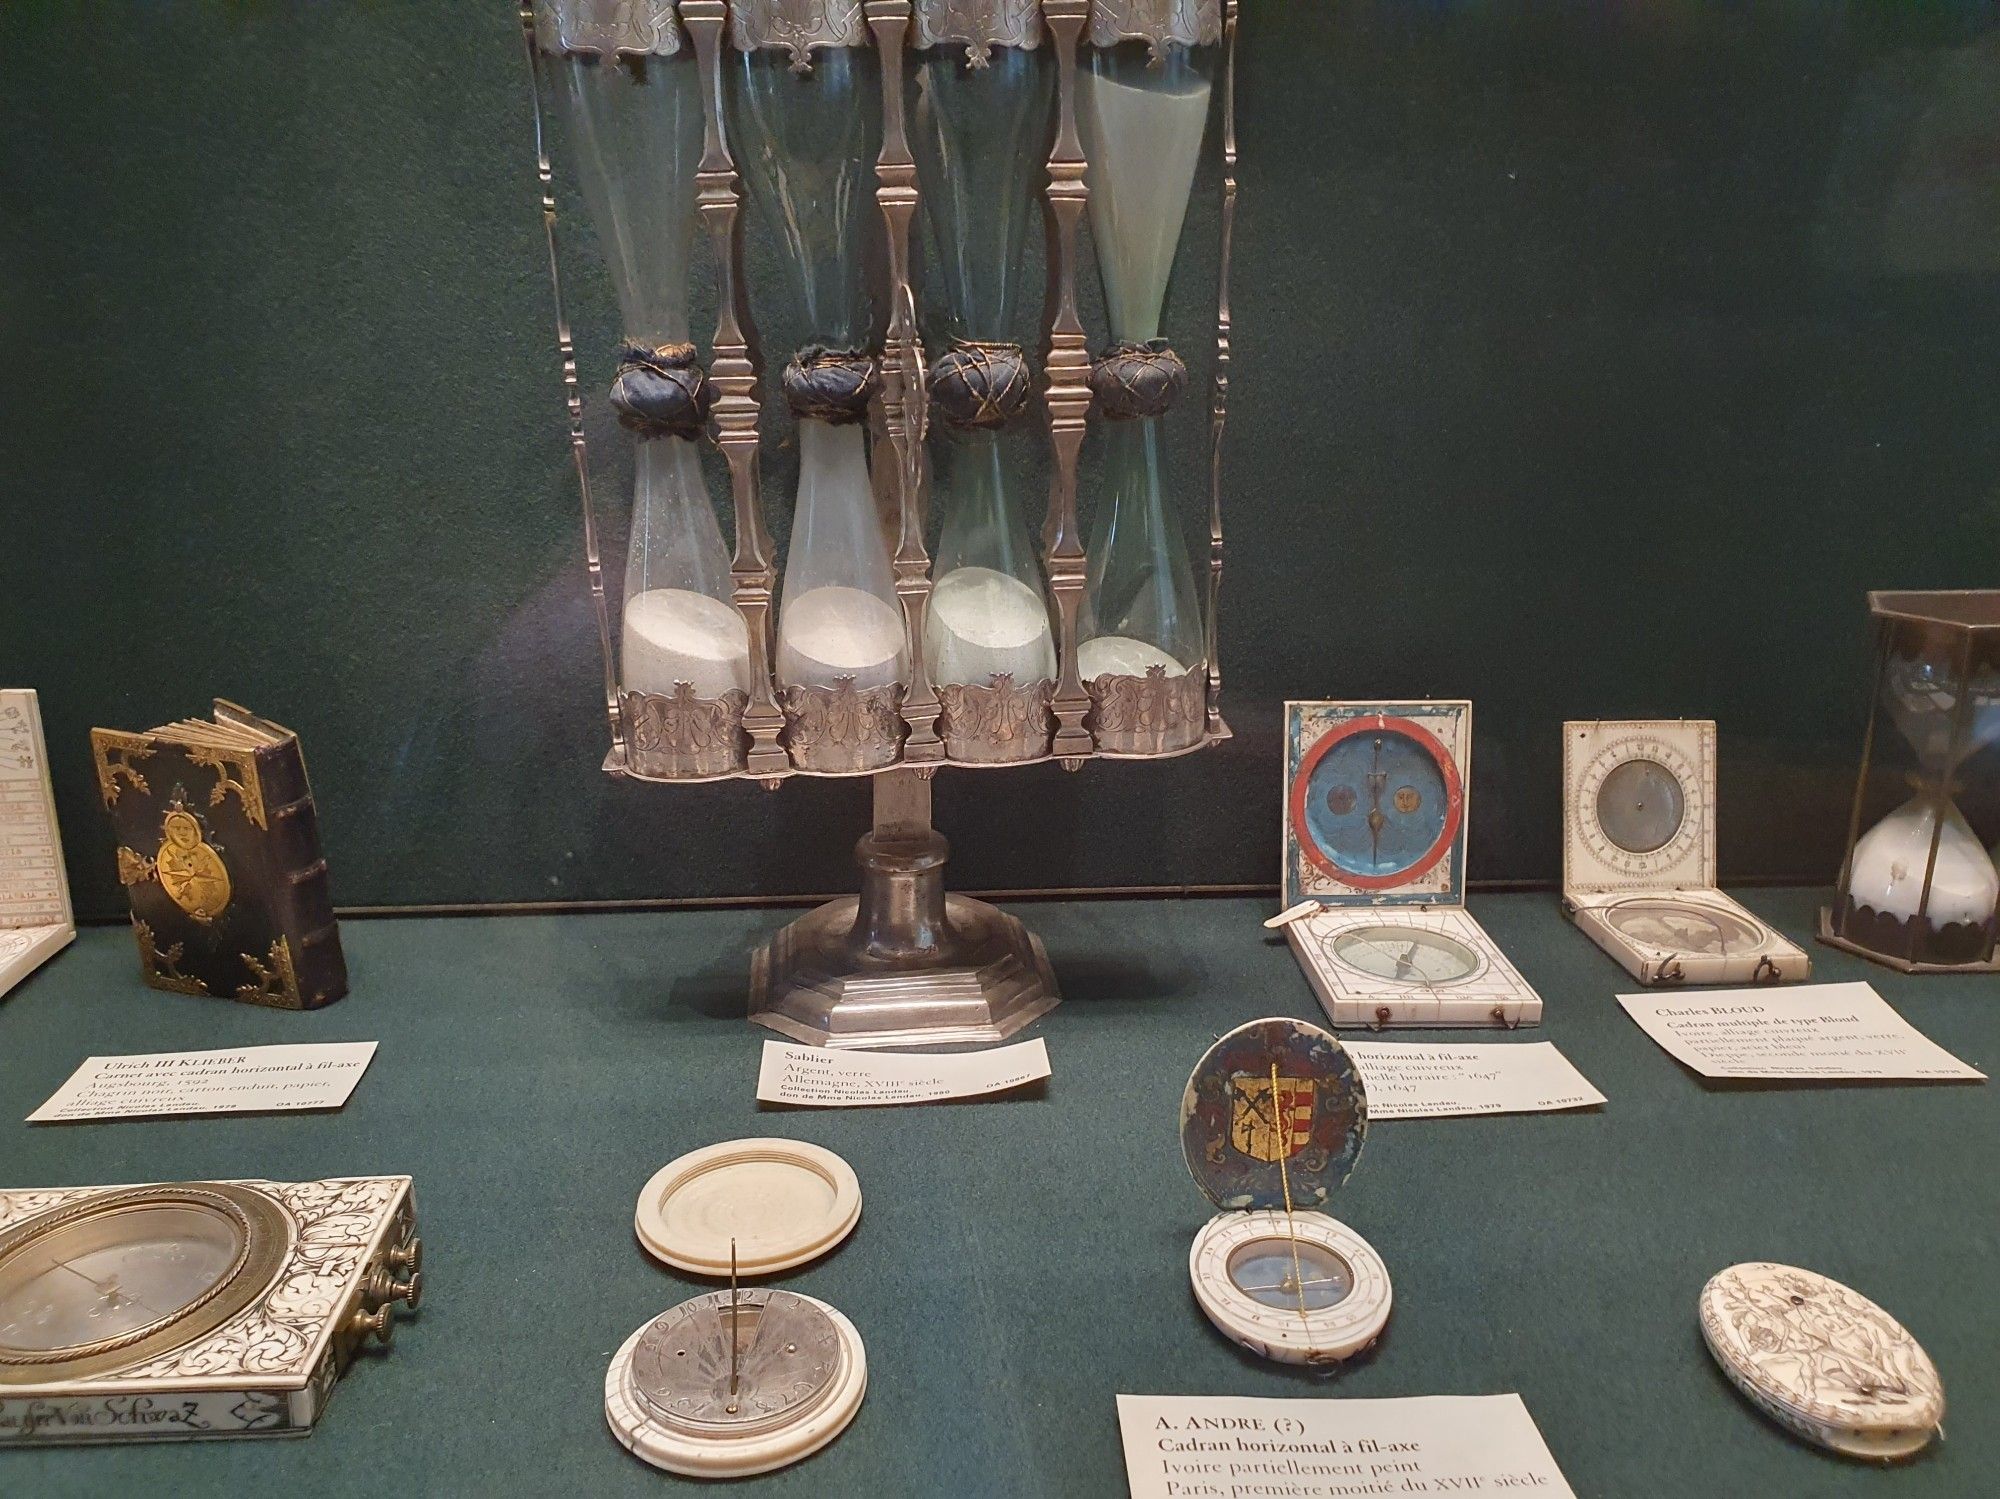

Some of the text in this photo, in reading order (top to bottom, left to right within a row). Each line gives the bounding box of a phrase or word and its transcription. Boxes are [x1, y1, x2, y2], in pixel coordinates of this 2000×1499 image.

[1655, 1006, 1765, 1017] Charles BLOUD
[1666, 1021, 1715, 1029] Cadran
[1717, 1018, 1770, 1028] multiple
[1790, 1018, 1819, 1026] type
[1819, 1014, 1860, 1023] Bloud
[1721, 1028, 1760, 1037] alliage
[784, 1051, 834, 1064] Sablier
[1357, 1051, 1425, 1061] horizontal
[1429, 1052, 1436, 1061] à
[1438, 1052, 1479, 1061] fil-axe
[104, 1056, 247, 1070] Ulrich III KLIEBER
[1359, 1062, 1463, 1072] alliage cuivreux
[94, 1071, 143, 1080] Carnet
[180, 1068, 227, 1077] cadran
[231, 1062, 304, 1074] horizontal
[305, 1062, 313, 1071] à
[316, 1060, 361, 1070] fil-axe
[784, 1063, 872, 1078] Argent, verre
[1363, 1072, 1397, 1081] helle
[1399, 1072, 1450, 1081] horaire
[782, 1074, 860, 1089] Allemagne,
[909, 1077, 944, 1087] siècle
[986, 1081, 1001, 1089] OA
[1387, 1083, 1417, 1092] 1647
[76, 1089, 137, 1098] Chagrin
[178, 1085, 225, 1093] carton
[779, 1091, 799, 1099] don
[780, 1084, 831, 1095] Collection
[66, 1099, 117, 1107] alliage
[1155, 1415, 1305, 1436] A. ANDRE (?)
[1157, 1436, 1422, 1454] Cadran horizontal à fil-axe
[1162, 1458, 1422, 1478] Ivoire partiellement peint
[1166, 1480, 1225, 1497] Paris,
[1231, 1480, 1322, 1499] première
[1329, 1479, 1393, 1496] moitié
[1401, 1477, 1428, 1491] du
[1493, 1471, 1549, 1488] siècle
